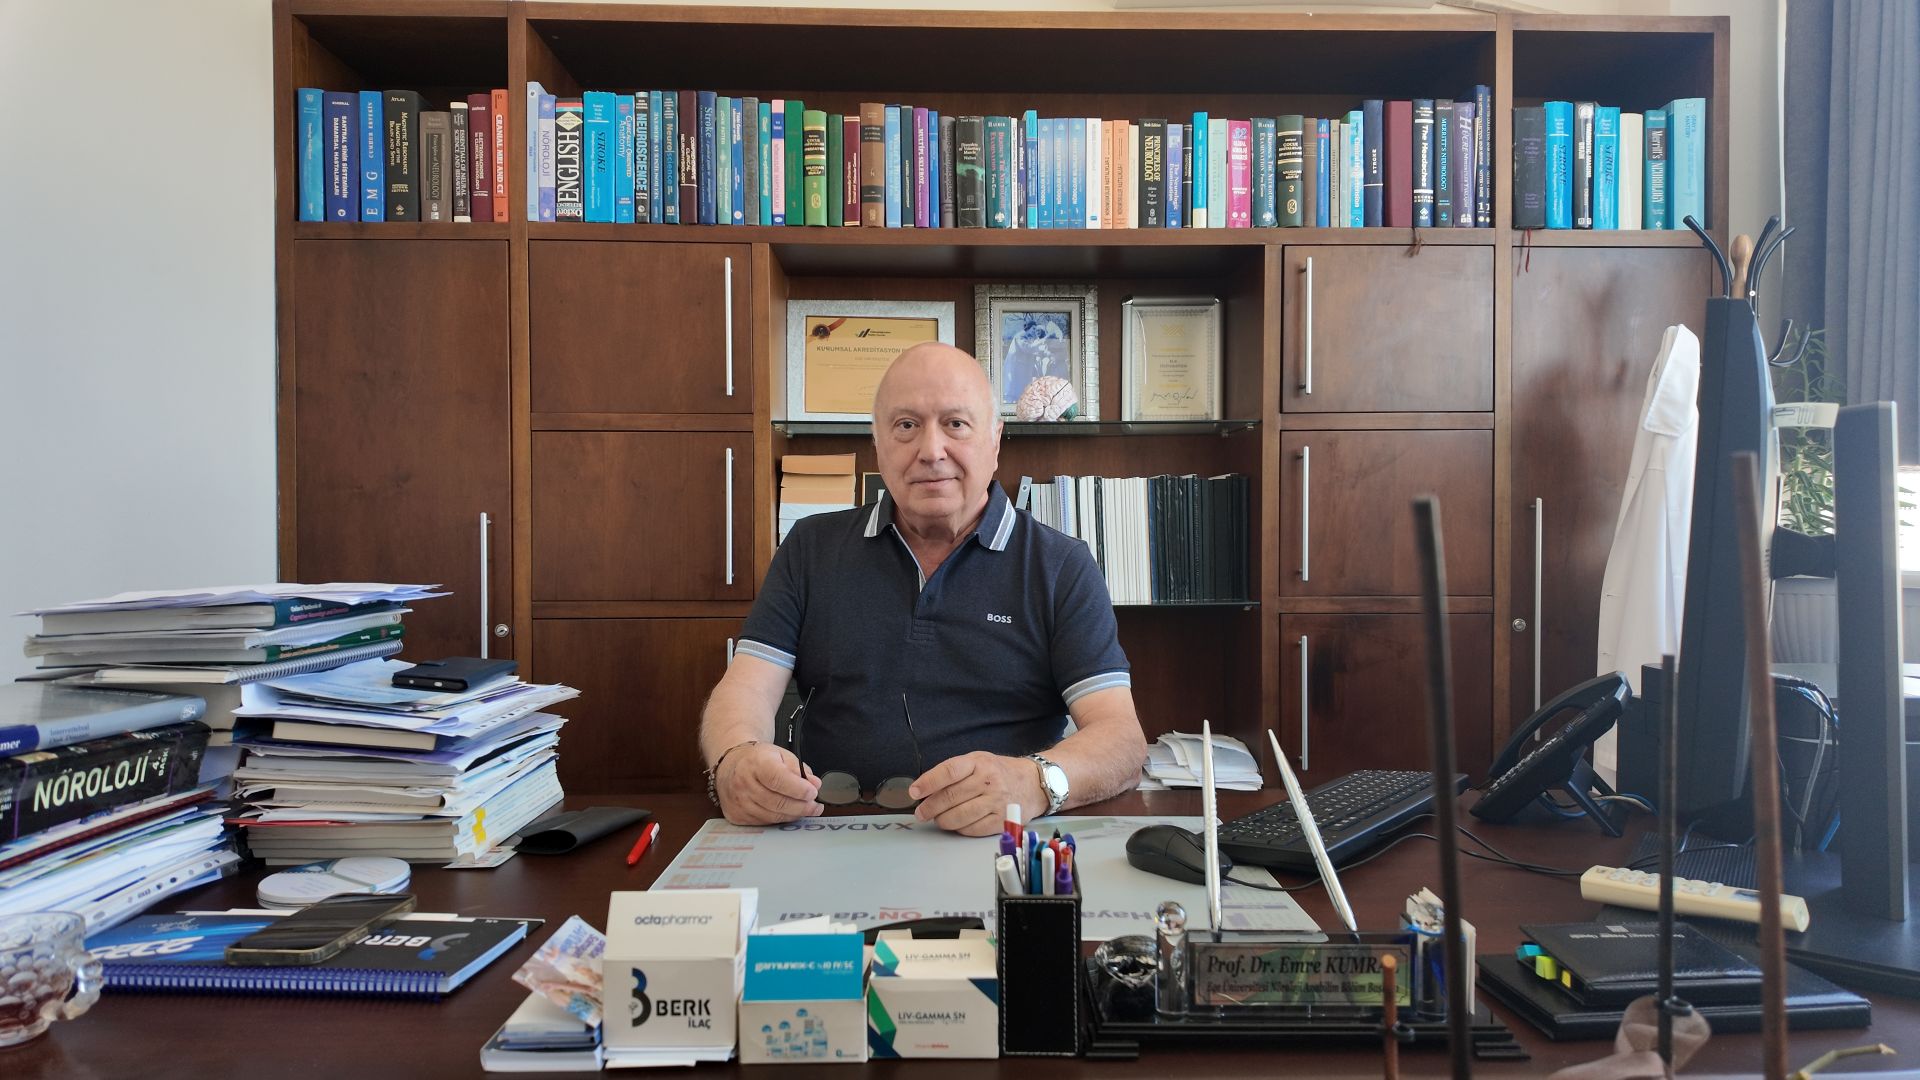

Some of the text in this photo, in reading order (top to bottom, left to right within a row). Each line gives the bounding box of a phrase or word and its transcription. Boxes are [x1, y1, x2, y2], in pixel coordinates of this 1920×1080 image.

[598, 131, 606, 173] STROKE
[636, 113, 647, 191] NEUROSCIENCE
[1144, 135, 1154, 182] NEUROLOGY
[558, 131, 579, 202] ENGLISH
[1154, 172, 1160, 181] OF
[432, 163, 440, 199] NEUROLOGY
[496, 184, 503, 194] CT
[1652, 163, 1664, 204] NEUROLOGY
[987, 614, 1012, 624] BOSS
[34, 750, 152, 812] NÖROLOJİ
[778, 822, 914, 832] XADAGO
[1207, 956, 1400, 977] Prof. Dr. Emre KUMR
[655, 999, 711, 1016] BERK
[688, 1017, 711, 1030] İLAÇ
